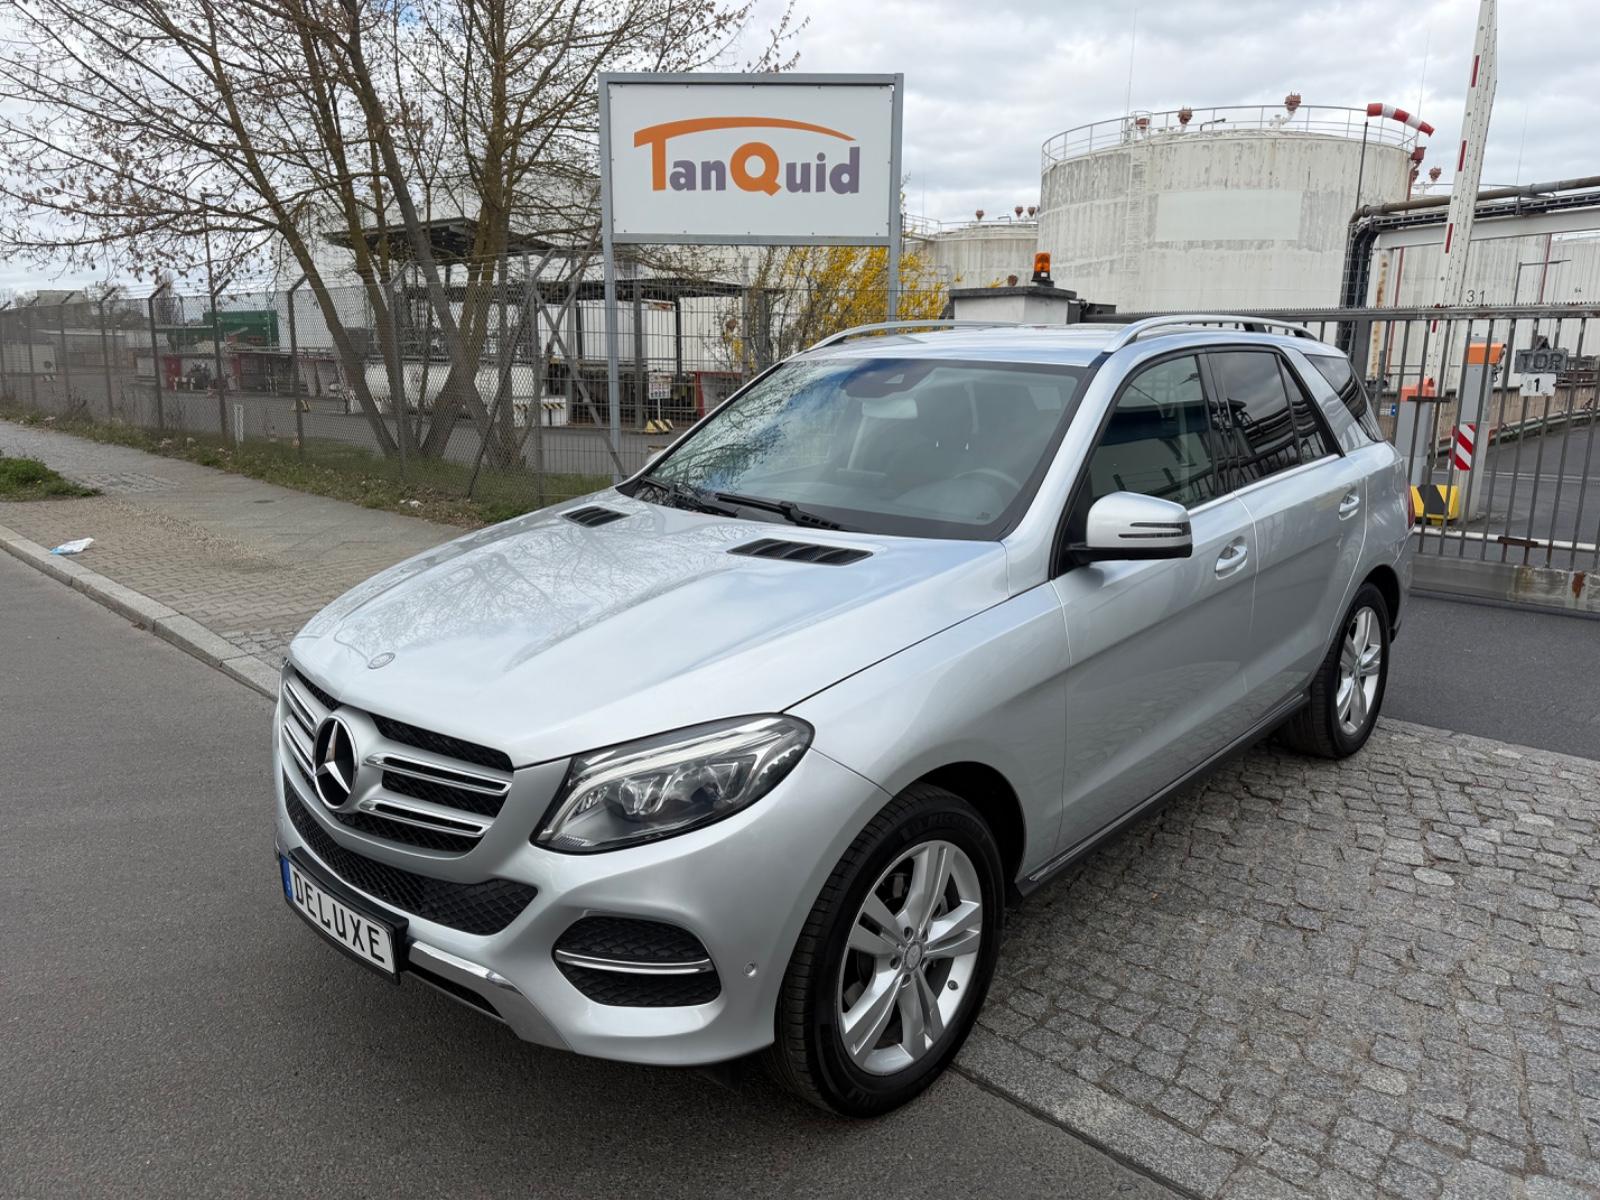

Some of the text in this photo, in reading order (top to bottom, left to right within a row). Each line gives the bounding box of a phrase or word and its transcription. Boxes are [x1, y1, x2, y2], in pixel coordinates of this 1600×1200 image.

[634, 116, 860, 196] TanQuid
[1520, 352, 1564, 371] TOR
[293, 870, 385, 963] DELUXE
